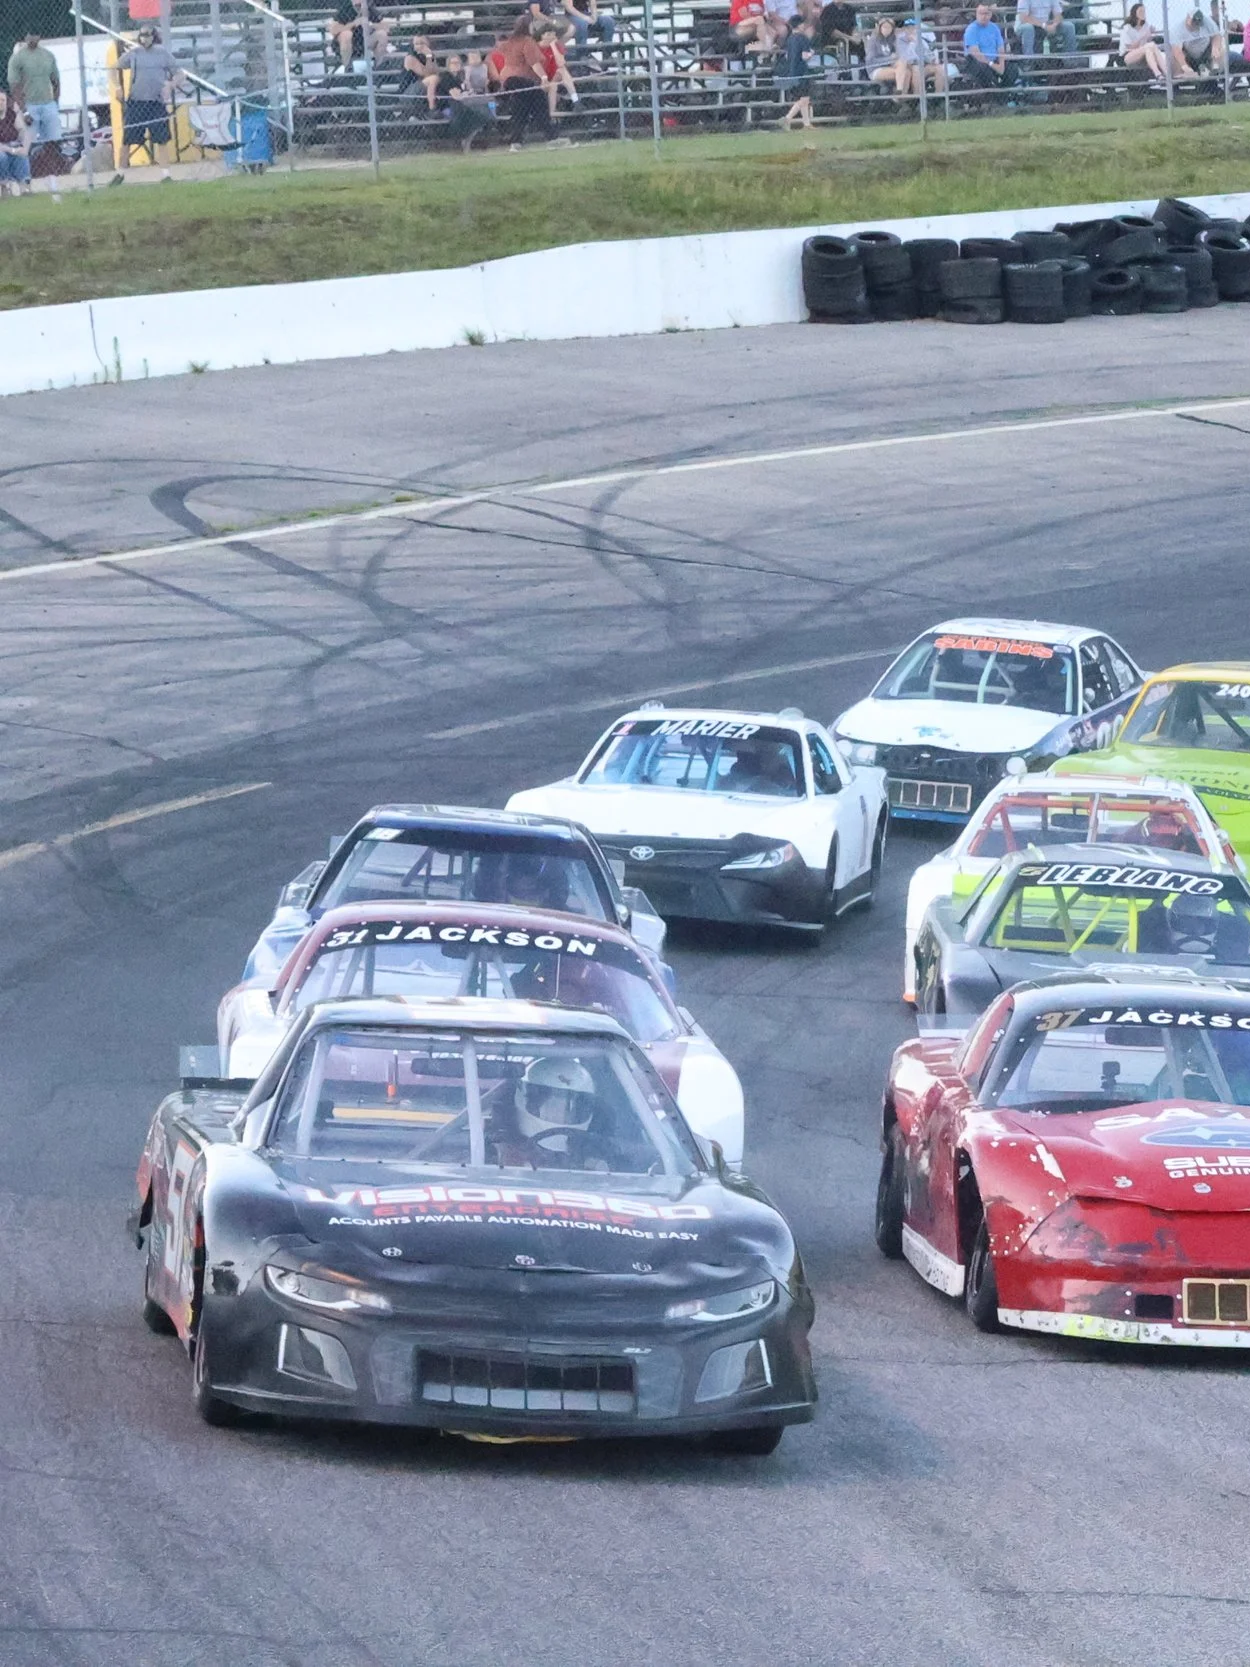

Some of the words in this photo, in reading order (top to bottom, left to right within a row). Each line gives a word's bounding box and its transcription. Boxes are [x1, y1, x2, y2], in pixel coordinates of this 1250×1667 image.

[650, 720, 761, 740] MARIER
[1037, 864, 1224, 895] LEBLANC
[326, 928, 363, 949] 31
[375, 925, 597, 956] JACKSON
[1036, 1010, 1083, 1032] 37
[415, 1214, 483, 1224] PAYABLE
[487, 1215, 601, 1231] AUTOMATION
[606, 1225, 654, 1240] MADE
[658, 1231, 700, 1242] EASY
